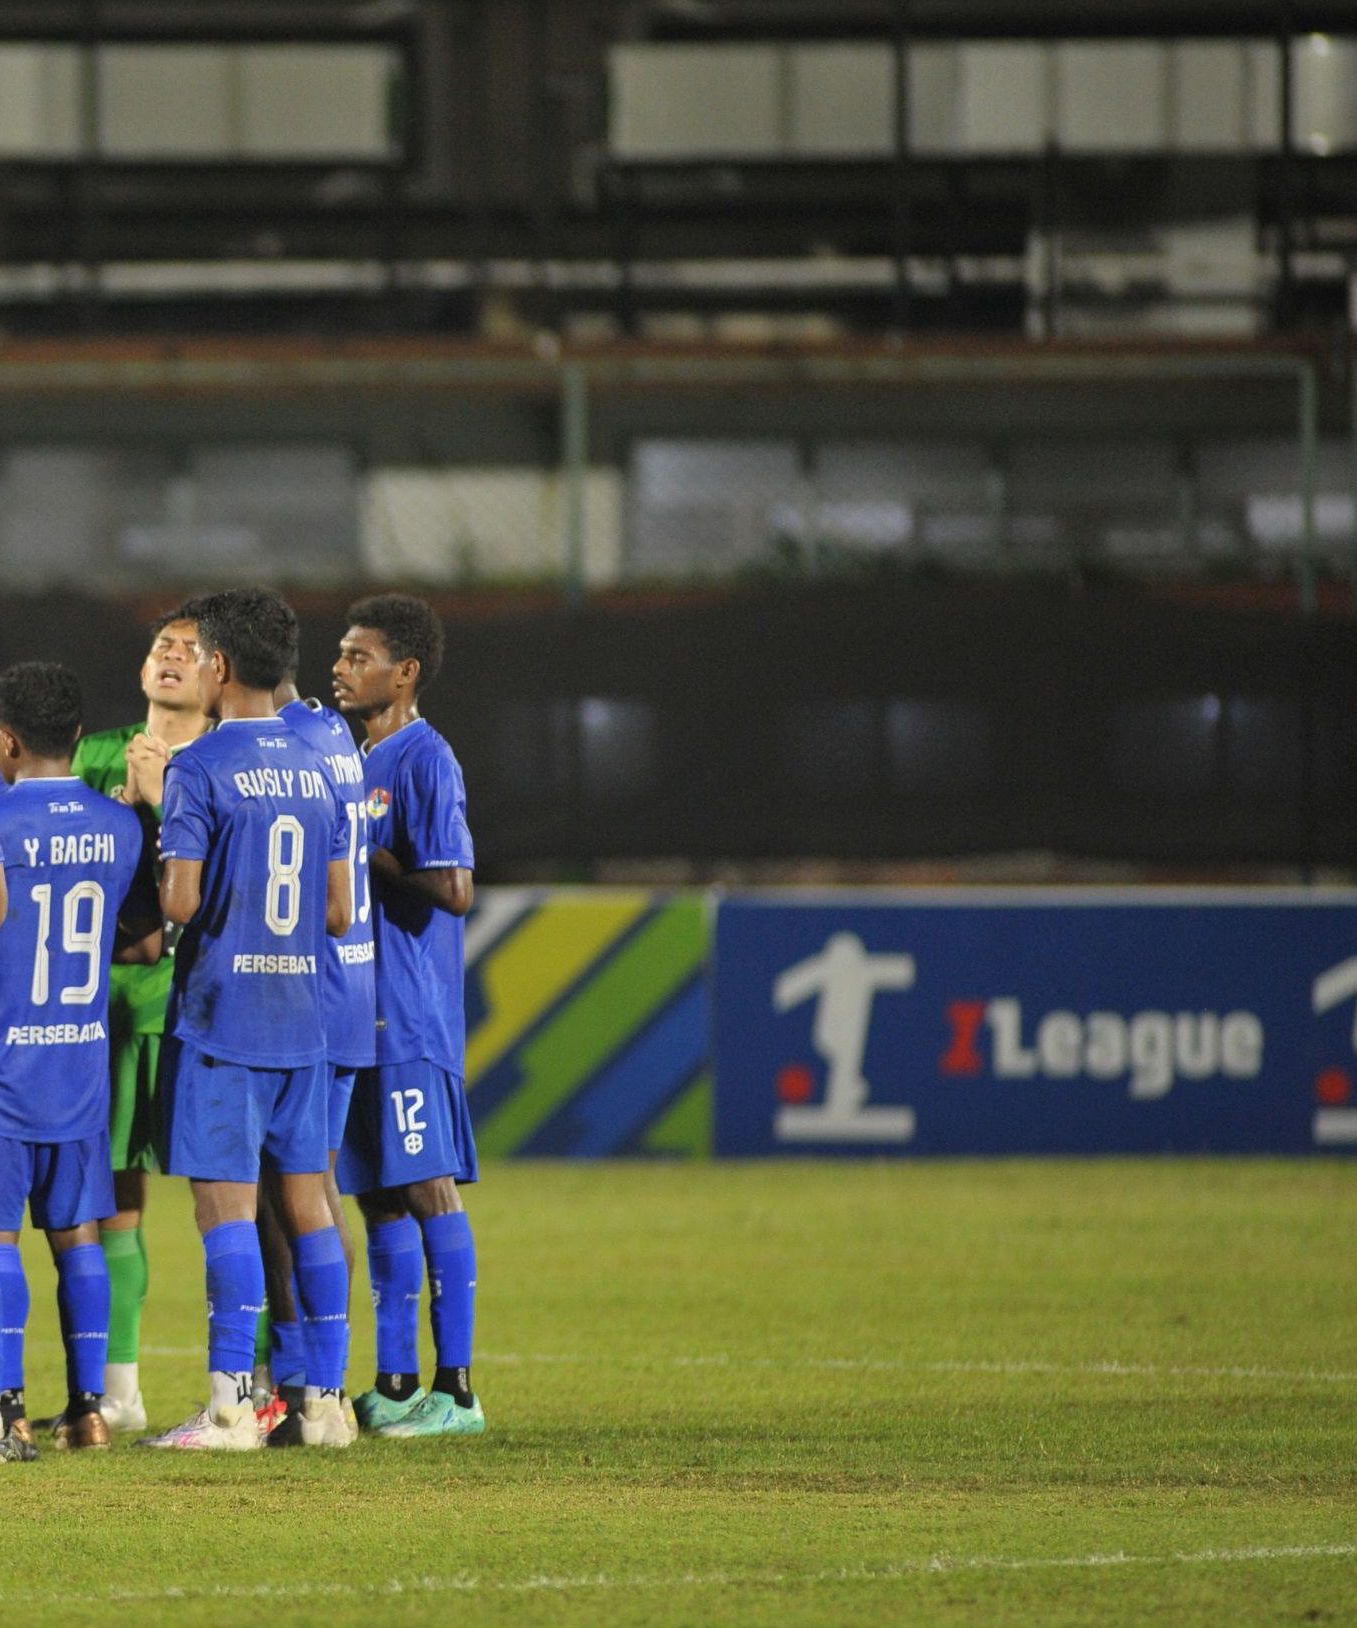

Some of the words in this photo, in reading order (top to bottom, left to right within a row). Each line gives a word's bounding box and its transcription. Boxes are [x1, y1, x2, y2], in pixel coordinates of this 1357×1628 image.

[234, 768, 294, 798] RUSLY
[24, 839, 45, 867] Y.
[51, 834, 115, 864] BAGHI
[265, 814, 305, 936] 8
[32, 881, 105, 1005] 19
[6, 1021, 106, 1046] PERSEBATA
[391, 1088, 427, 1133] 12
